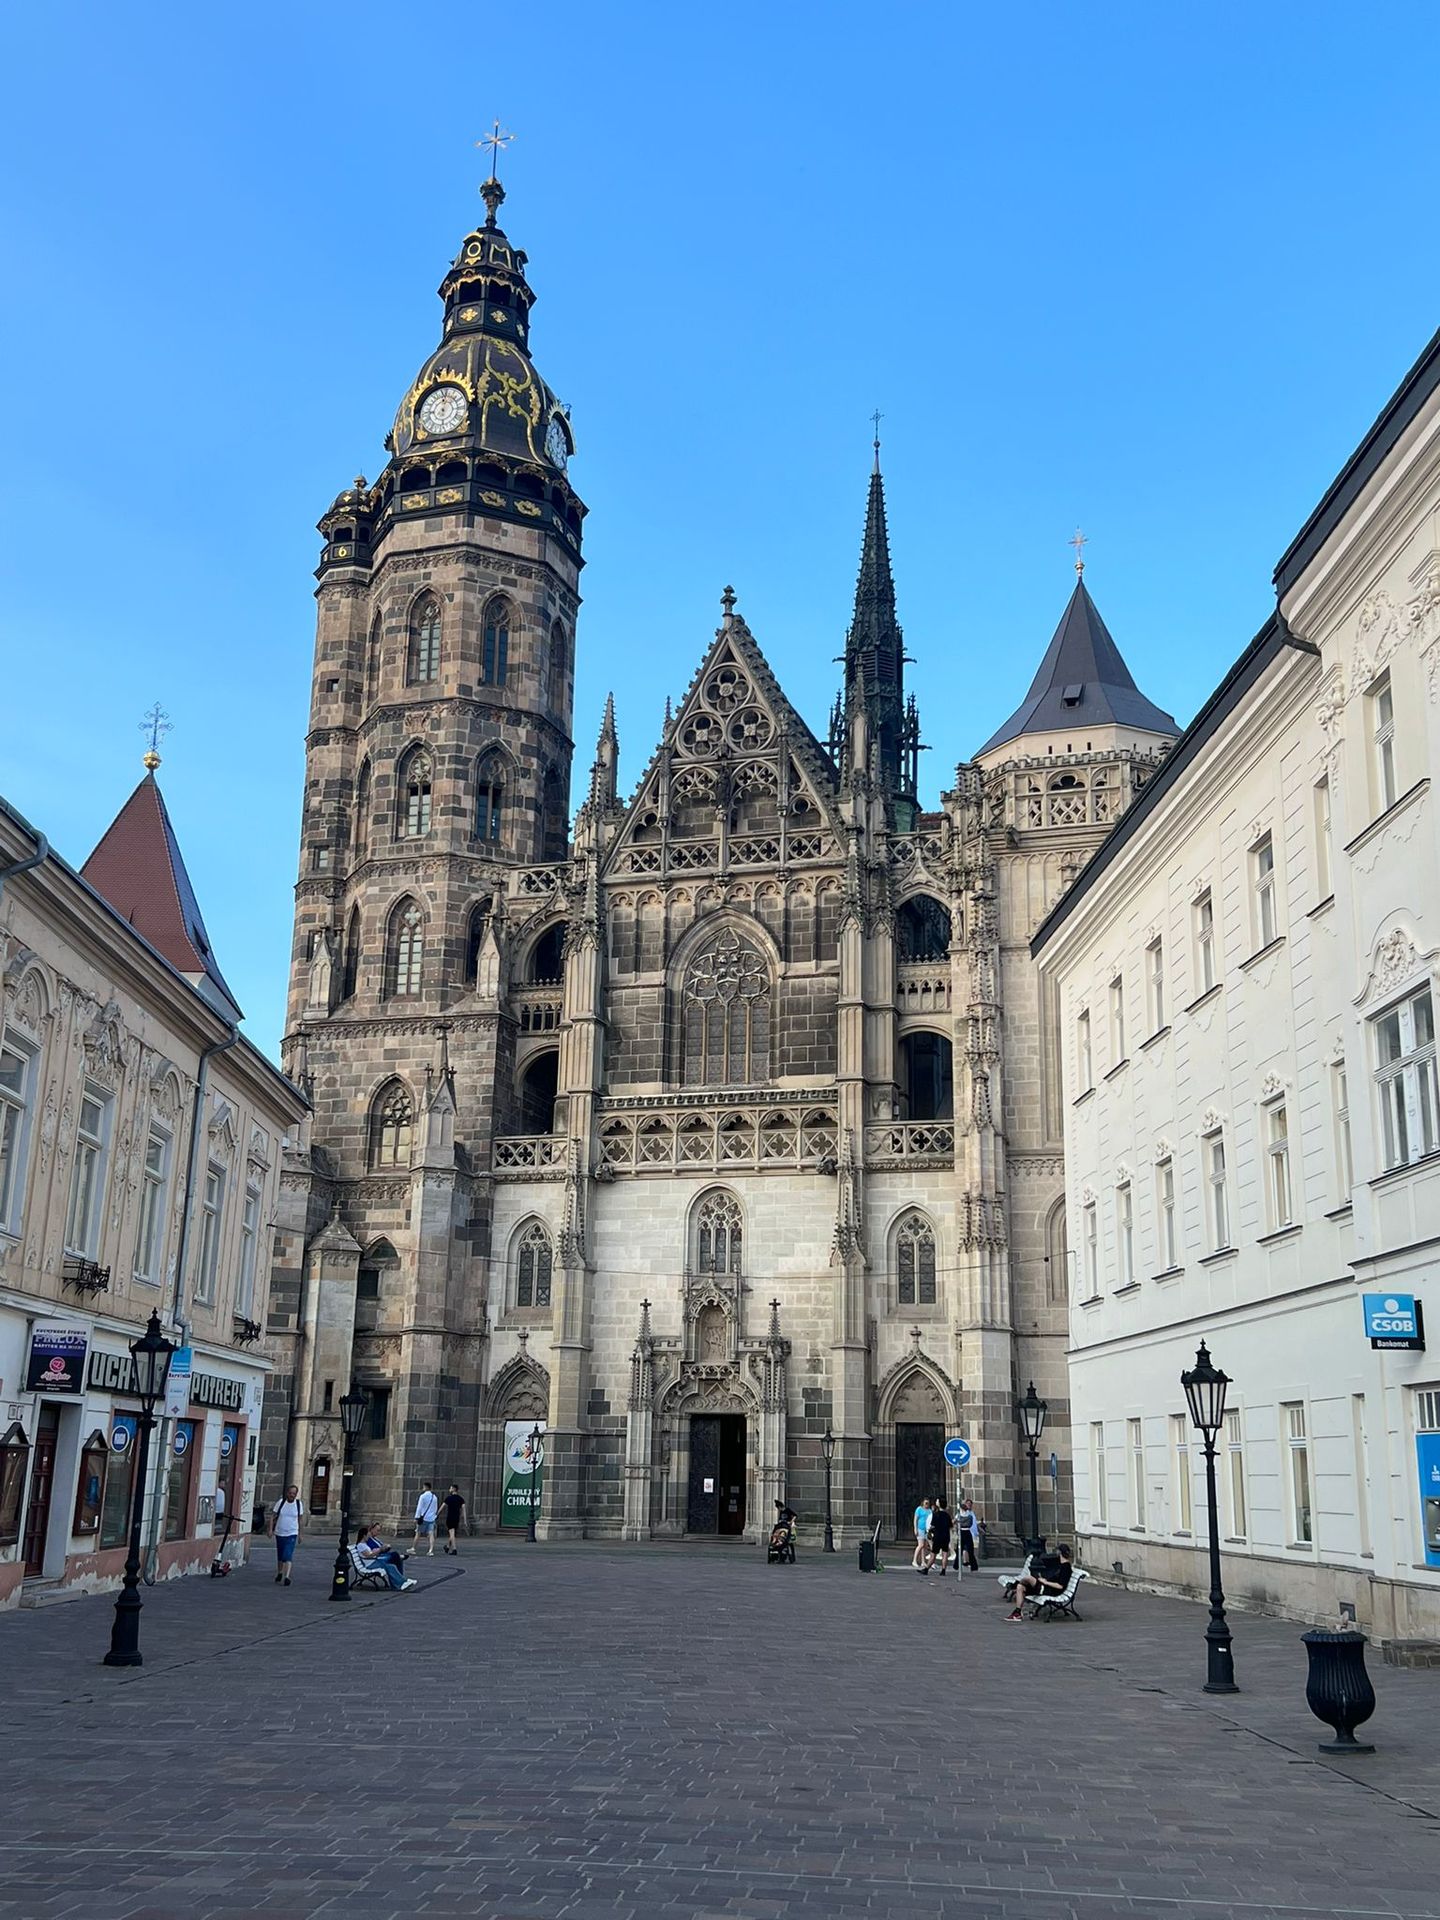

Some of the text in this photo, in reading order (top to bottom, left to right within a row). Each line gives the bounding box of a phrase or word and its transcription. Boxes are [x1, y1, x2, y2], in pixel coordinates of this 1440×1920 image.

[1372, 1318, 1414, 1332] ČSOB
[1376, 1340, 1409, 1348] Bankomat
[191, 1372, 246, 1408] POTREBY
[507, 1487, 541, 1496] JUBILEJÝ
